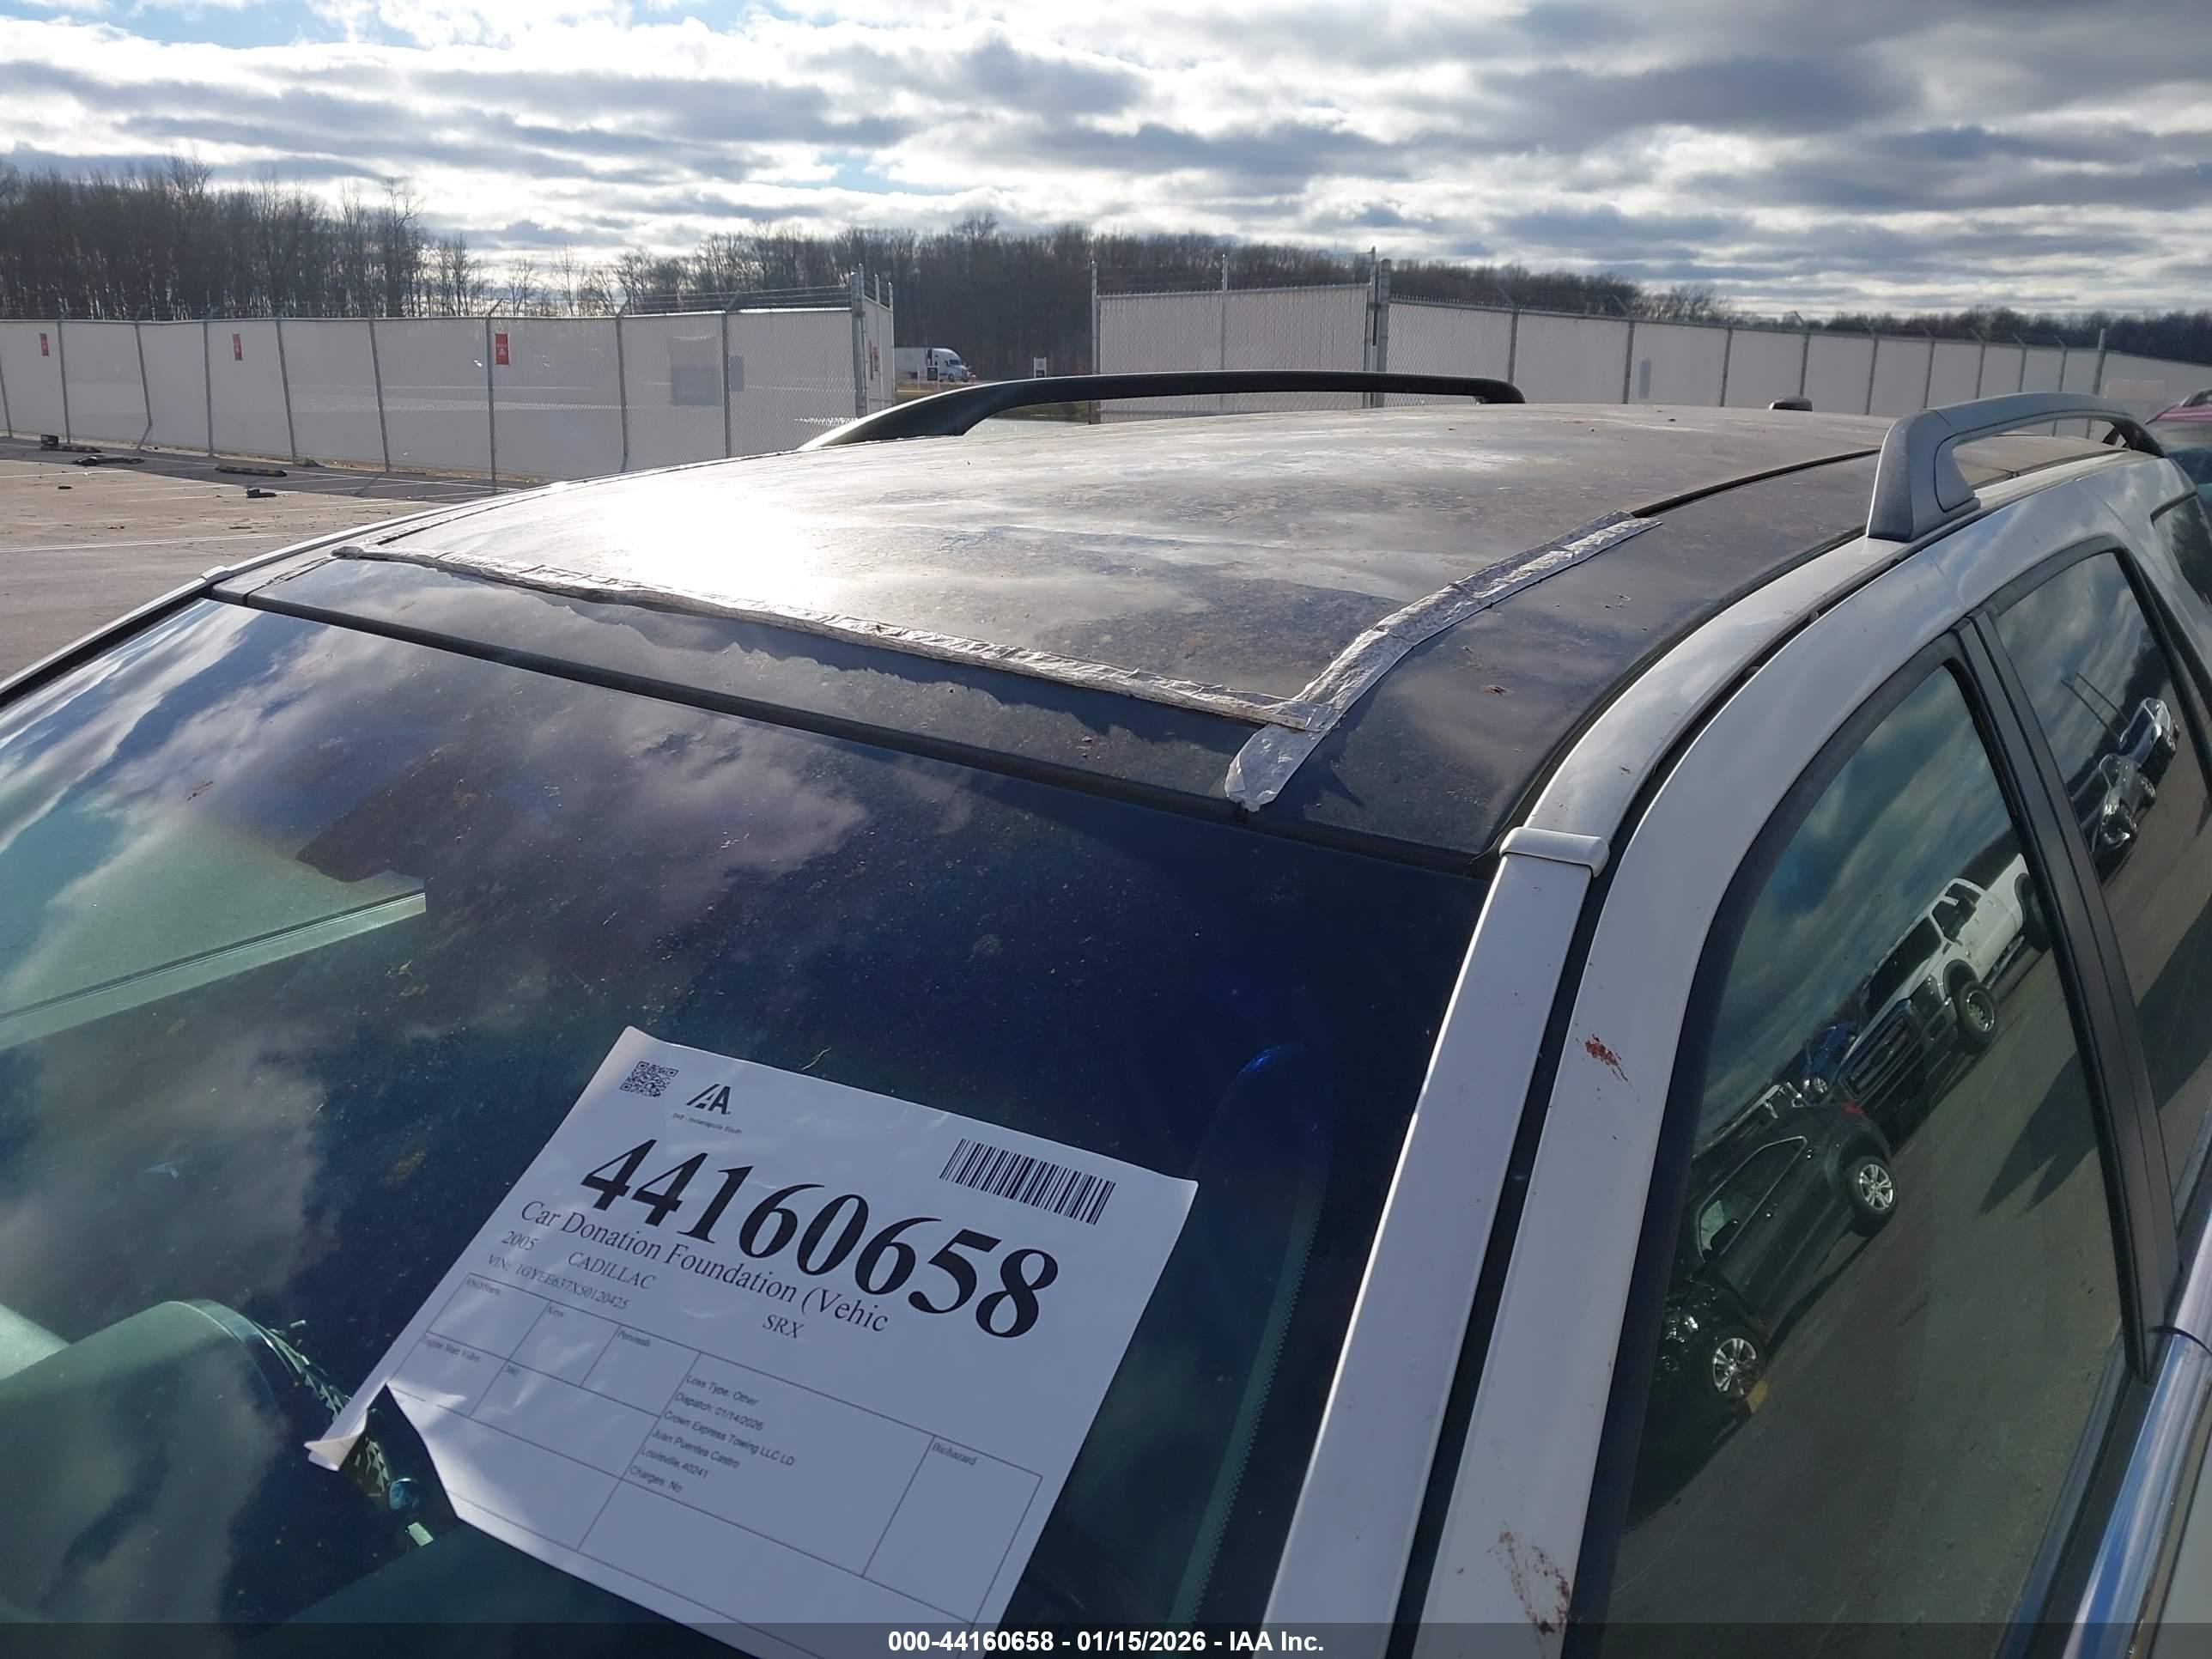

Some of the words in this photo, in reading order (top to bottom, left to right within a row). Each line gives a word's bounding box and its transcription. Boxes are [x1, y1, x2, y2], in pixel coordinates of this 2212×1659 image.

[580, 1139, 1058, 1338] 44160658
[488, 1254, 511, 1271] VIN:
[521, 1200, 560, 1227] Car
[560, 1212, 661, 1260] Donation
[664, 1243, 797, 1304] Foundation
[800, 1286, 889, 1333] (Vehic
[501, 1231, 538, 1251] 2005
[568, 1252, 656, 1290] CADILLAC
[762, 1314, 804, 1339] SRX
[686, 1375, 706, 1389] Loss
[732, 1391, 759, 1407] Other
[714, 1407, 765, 1431] 01/14/2026
[652, 1429, 673, 1444] Juan
[710, 1451, 740, 1469] Castro
[664, 1411, 690, 1426] Crown
[691, 1421, 726, 1442] Express
[728, 1434, 760, 1455] Towing
[760, 1447, 781, 1462] LLC
[781, 1454, 795, 1467] LD
[668, 1480, 683, 1492] No
[680, 1462, 708, 1479] 40241
